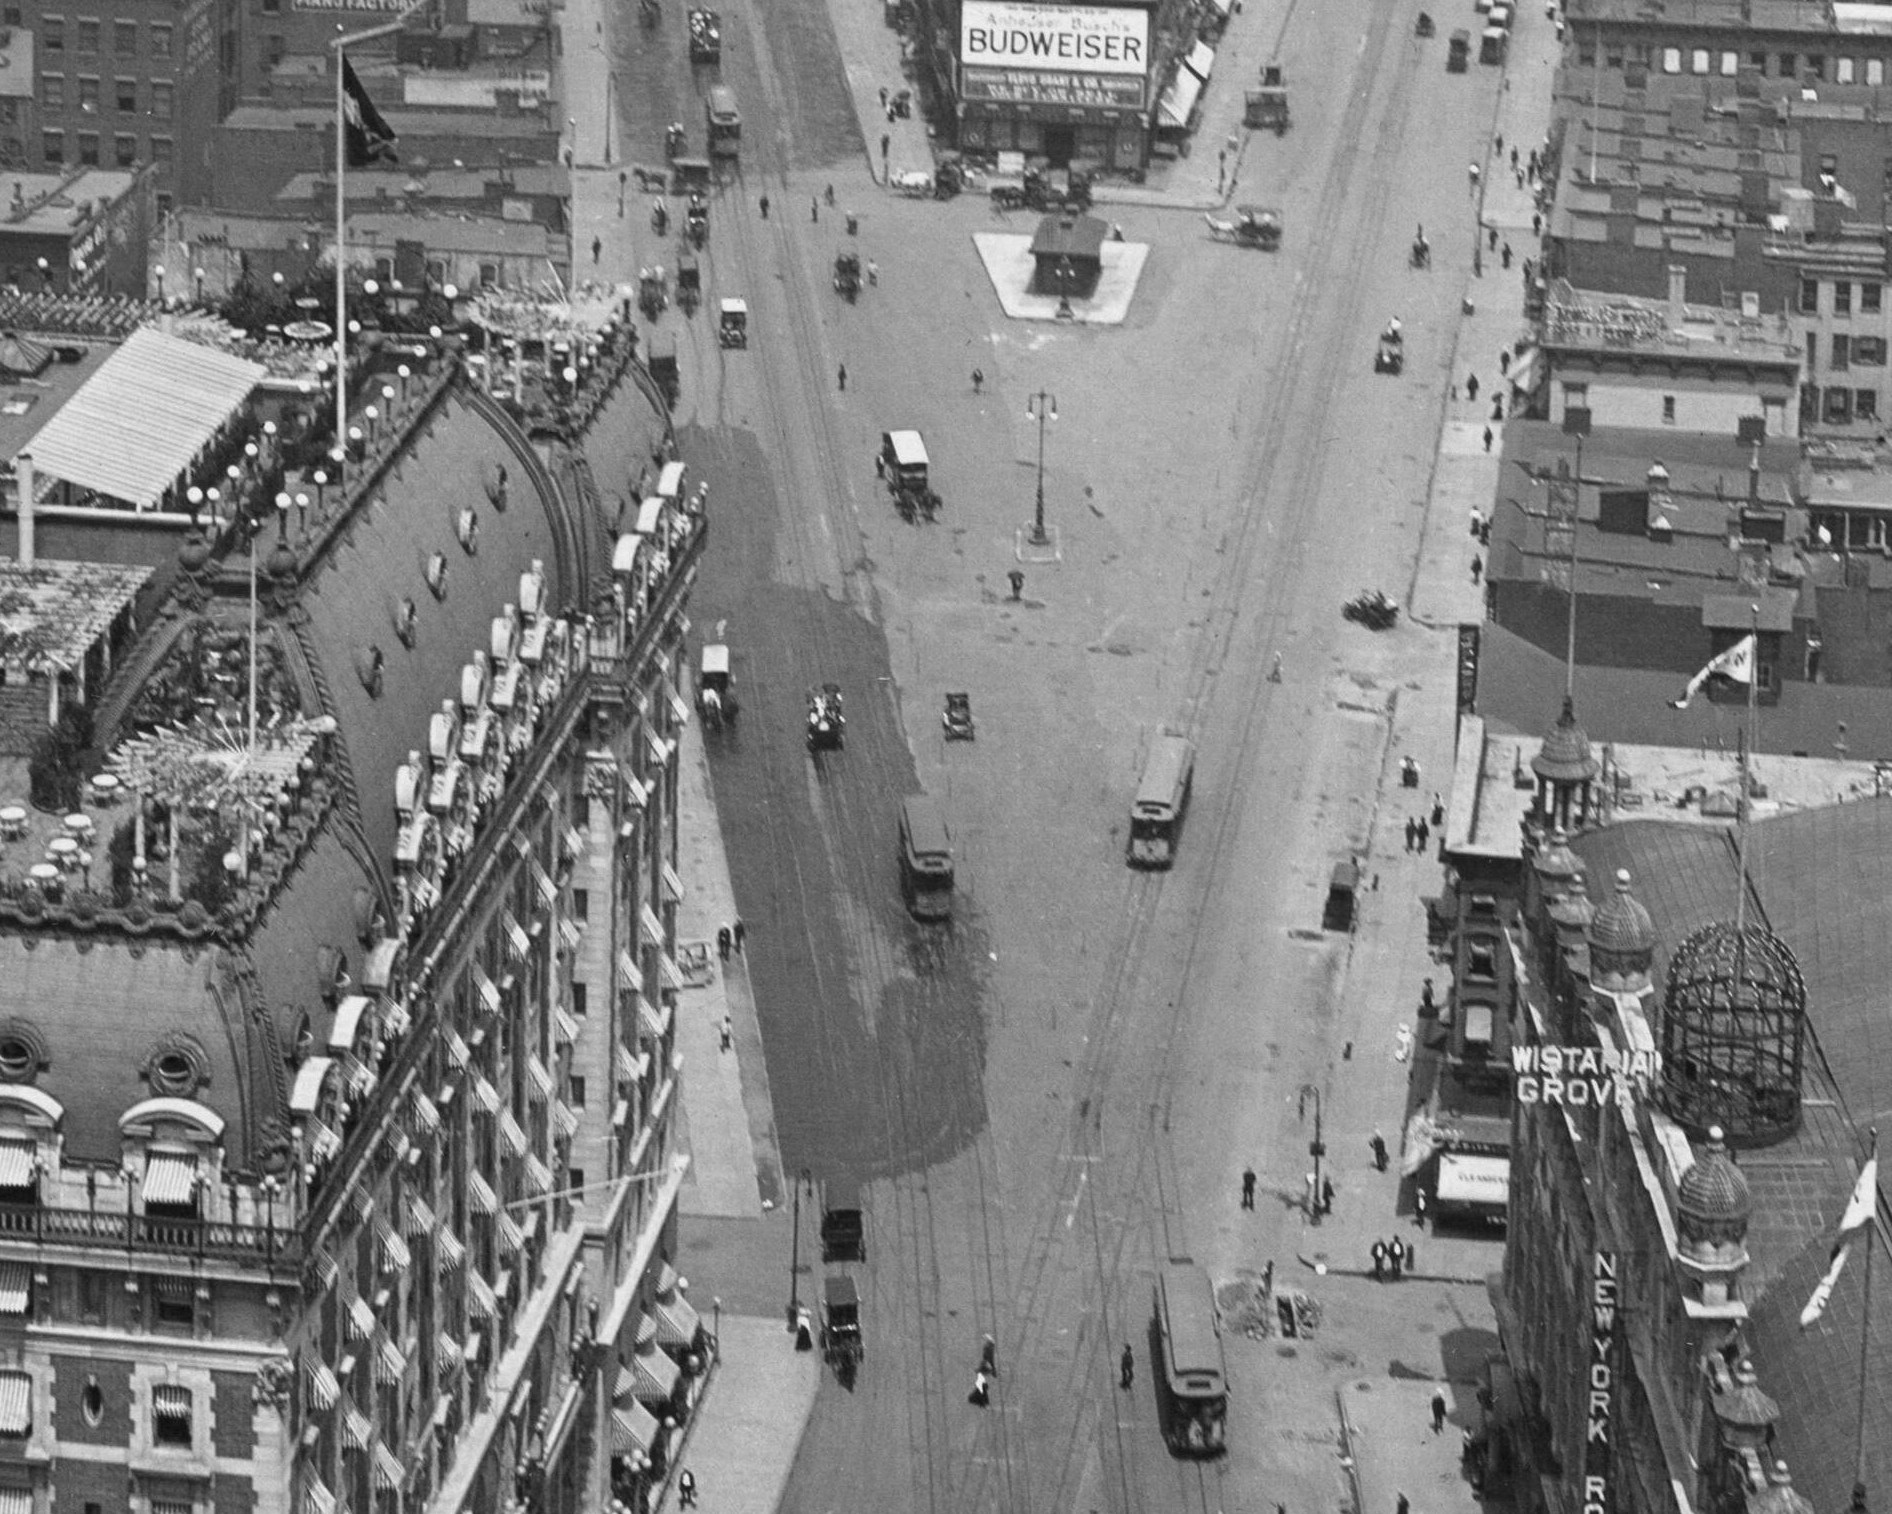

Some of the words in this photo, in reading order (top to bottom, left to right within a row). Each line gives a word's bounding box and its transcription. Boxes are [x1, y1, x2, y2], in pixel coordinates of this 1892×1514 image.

[968, 27, 1142, 62] BUDWEISER
[1517, 1076, 1635, 1108] GROVE
[1594, 1251, 1617, 1332] NEW
[1588, 1337, 1612, 1444] YORK
